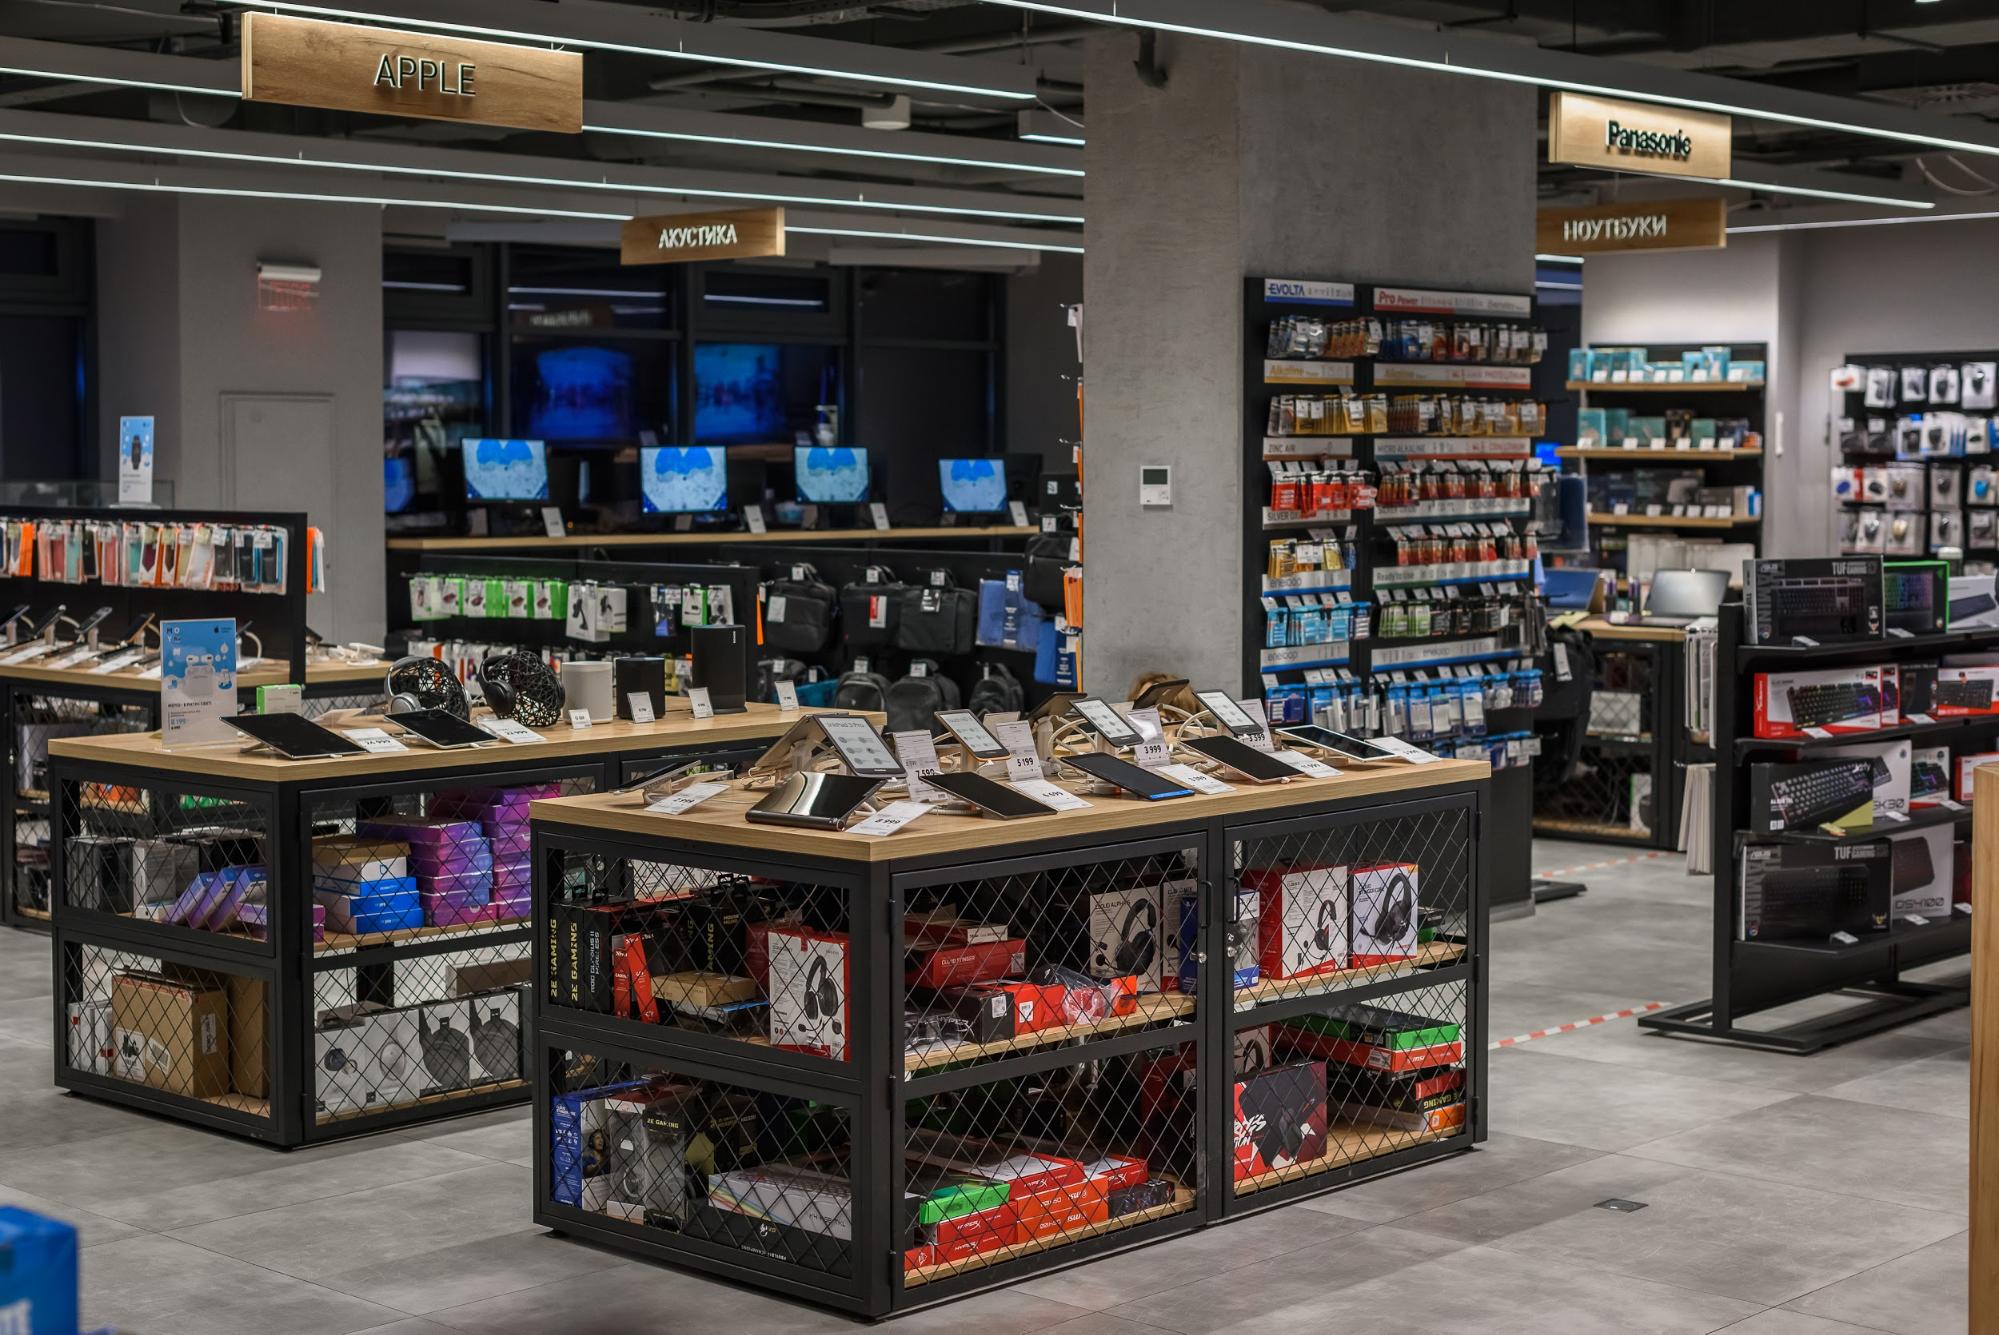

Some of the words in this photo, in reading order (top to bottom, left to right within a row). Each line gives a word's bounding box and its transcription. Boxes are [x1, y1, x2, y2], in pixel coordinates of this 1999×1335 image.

[374, 54, 477, 97] APPLE
[1606, 120, 1691, 155] Panasonic
[1564, 215, 1667, 242] НОУТБУКИ
[657, 223, 738, 249] АКУСТИКА
[1268, 283, 1305, 296] EVOLTA
[1378, 291, 1396, 303] Pro
[1267, 512, 1289, 521] SILVER
[1832, 562, 1846, 575] TUF
[1150, 744, 1162, 754] 999
[1022, 757, 1034, 766] 199
[1834, 847, 1851, 860] TUF
